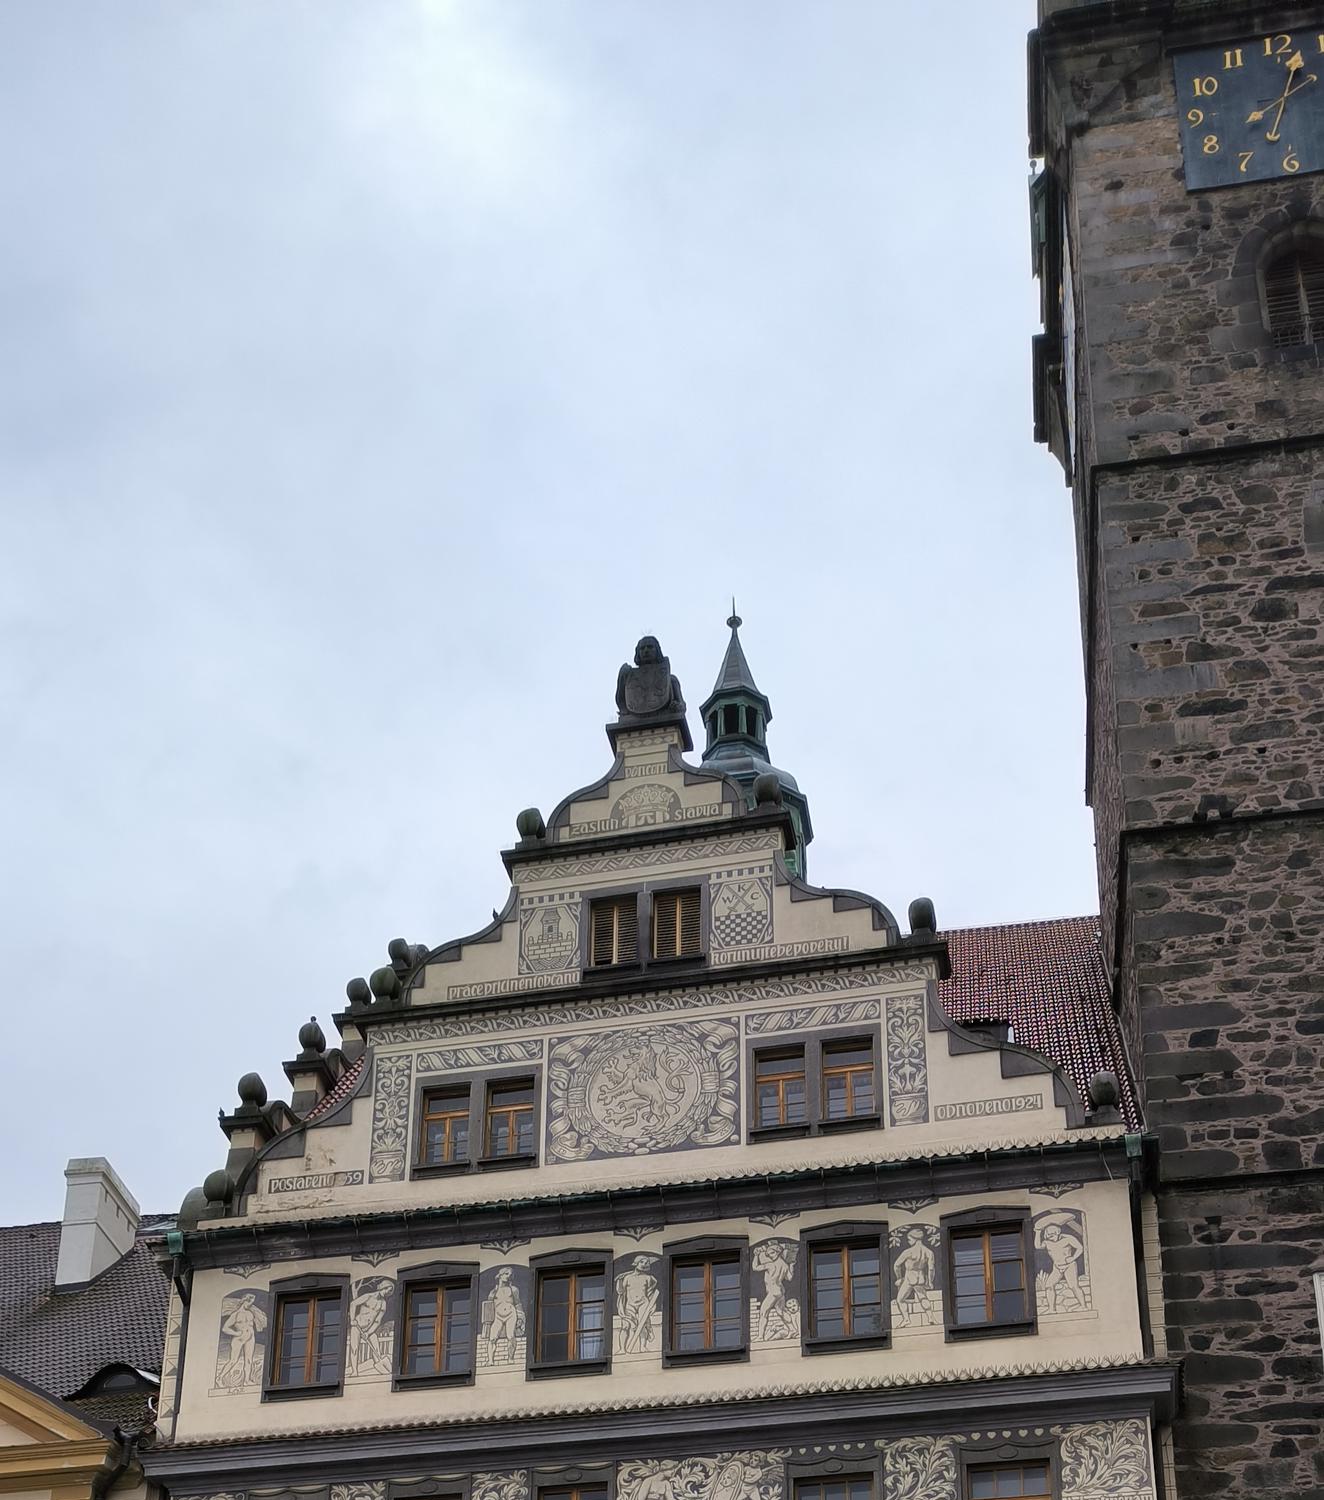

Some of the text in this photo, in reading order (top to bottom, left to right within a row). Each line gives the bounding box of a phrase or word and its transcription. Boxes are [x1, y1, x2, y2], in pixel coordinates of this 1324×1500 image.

[1263, 34, 1292, 56] 12
[1223, 48, 1244, 70] 11
[1192, 76, 1218, 97] 10
[1187, 108, 1204, 129] 9
[1203, 134, 1220, 154] 8
[1238, 151, 1254, 172] 7
[1282, 153, 1300, 173] 6
[737, 884, 747, 893] K
[722, 895, 736, 906] W
